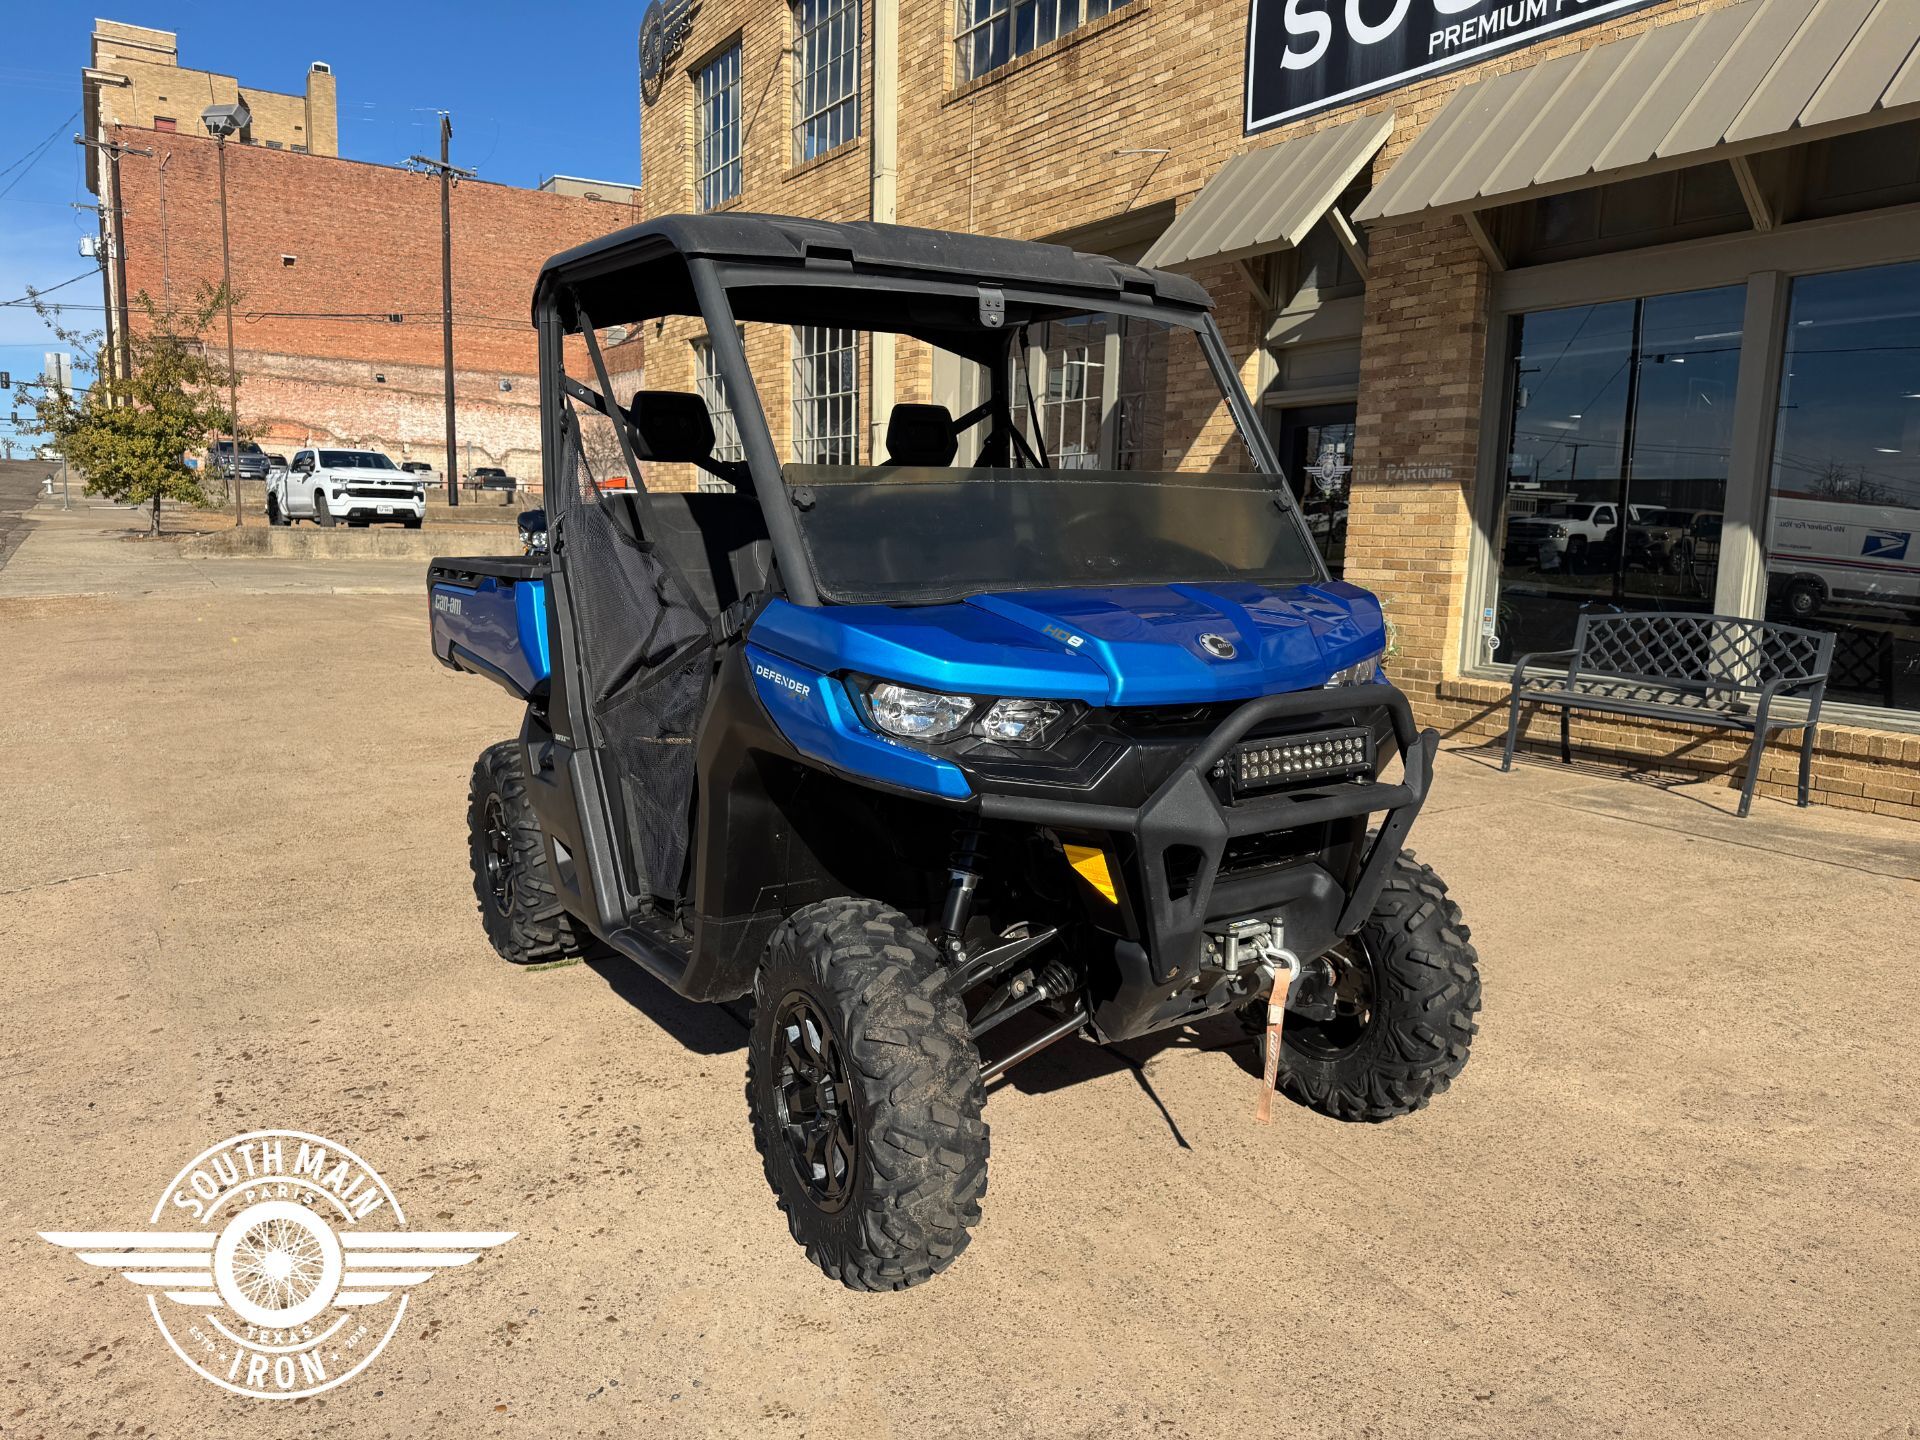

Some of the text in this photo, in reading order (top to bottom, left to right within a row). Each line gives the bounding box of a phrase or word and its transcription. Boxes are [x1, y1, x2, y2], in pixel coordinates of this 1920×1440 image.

[1280, 0, 1482, 70] SO
[1428, 0, 1548, 55] PREMIUM
[1385, 462, 1453, 481] PARKING
[1042, 624, 1084, 648] HD8
[756, 664, 810, 697] DEFENDER
